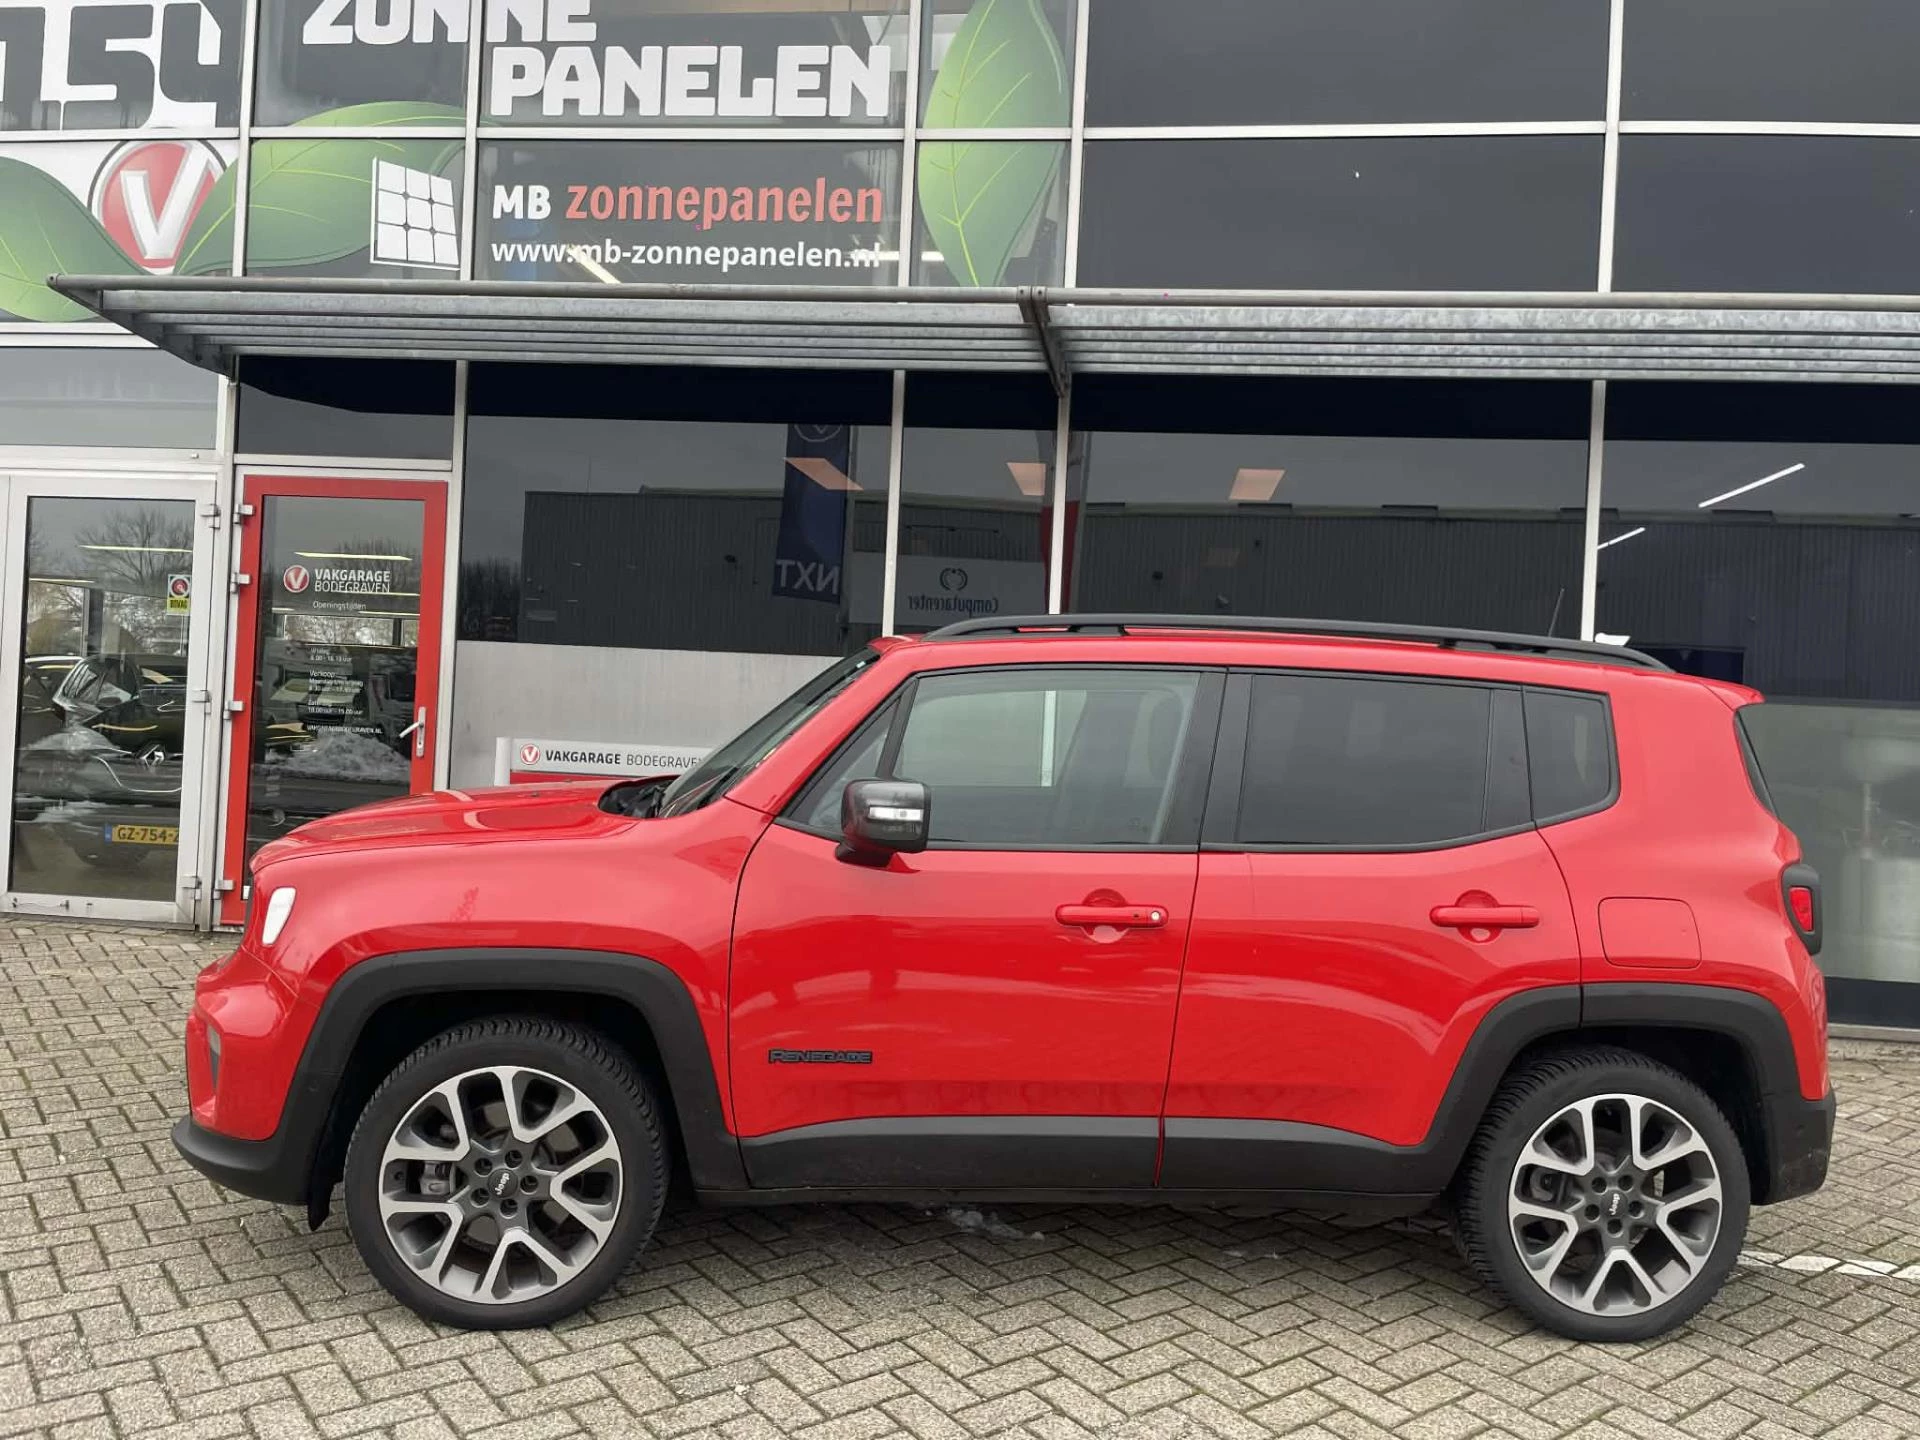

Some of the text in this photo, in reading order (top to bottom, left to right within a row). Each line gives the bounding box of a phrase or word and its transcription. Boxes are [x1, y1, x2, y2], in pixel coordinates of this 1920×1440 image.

[490, 45, 891, 117] PANELEN
[493, 177, 884, 231] MB zonnepanelen
[491, 239, 880, 272] www.mb-zonnepanelen.nl
[314, 568, 391, 583] VAKGARAGE
[314, 580, 391, 593] BODEGRAVEN
[312, 600, 367, 613] Openingstijden
[545, 750, 702, 769] VAKGARAGE BODEGRAVE
[768, 1049, 873, 1065] RENEGADE
[494, 1172, 510, 1196] Jeep
[1608, 1193, 1621, 1216] Jeep
